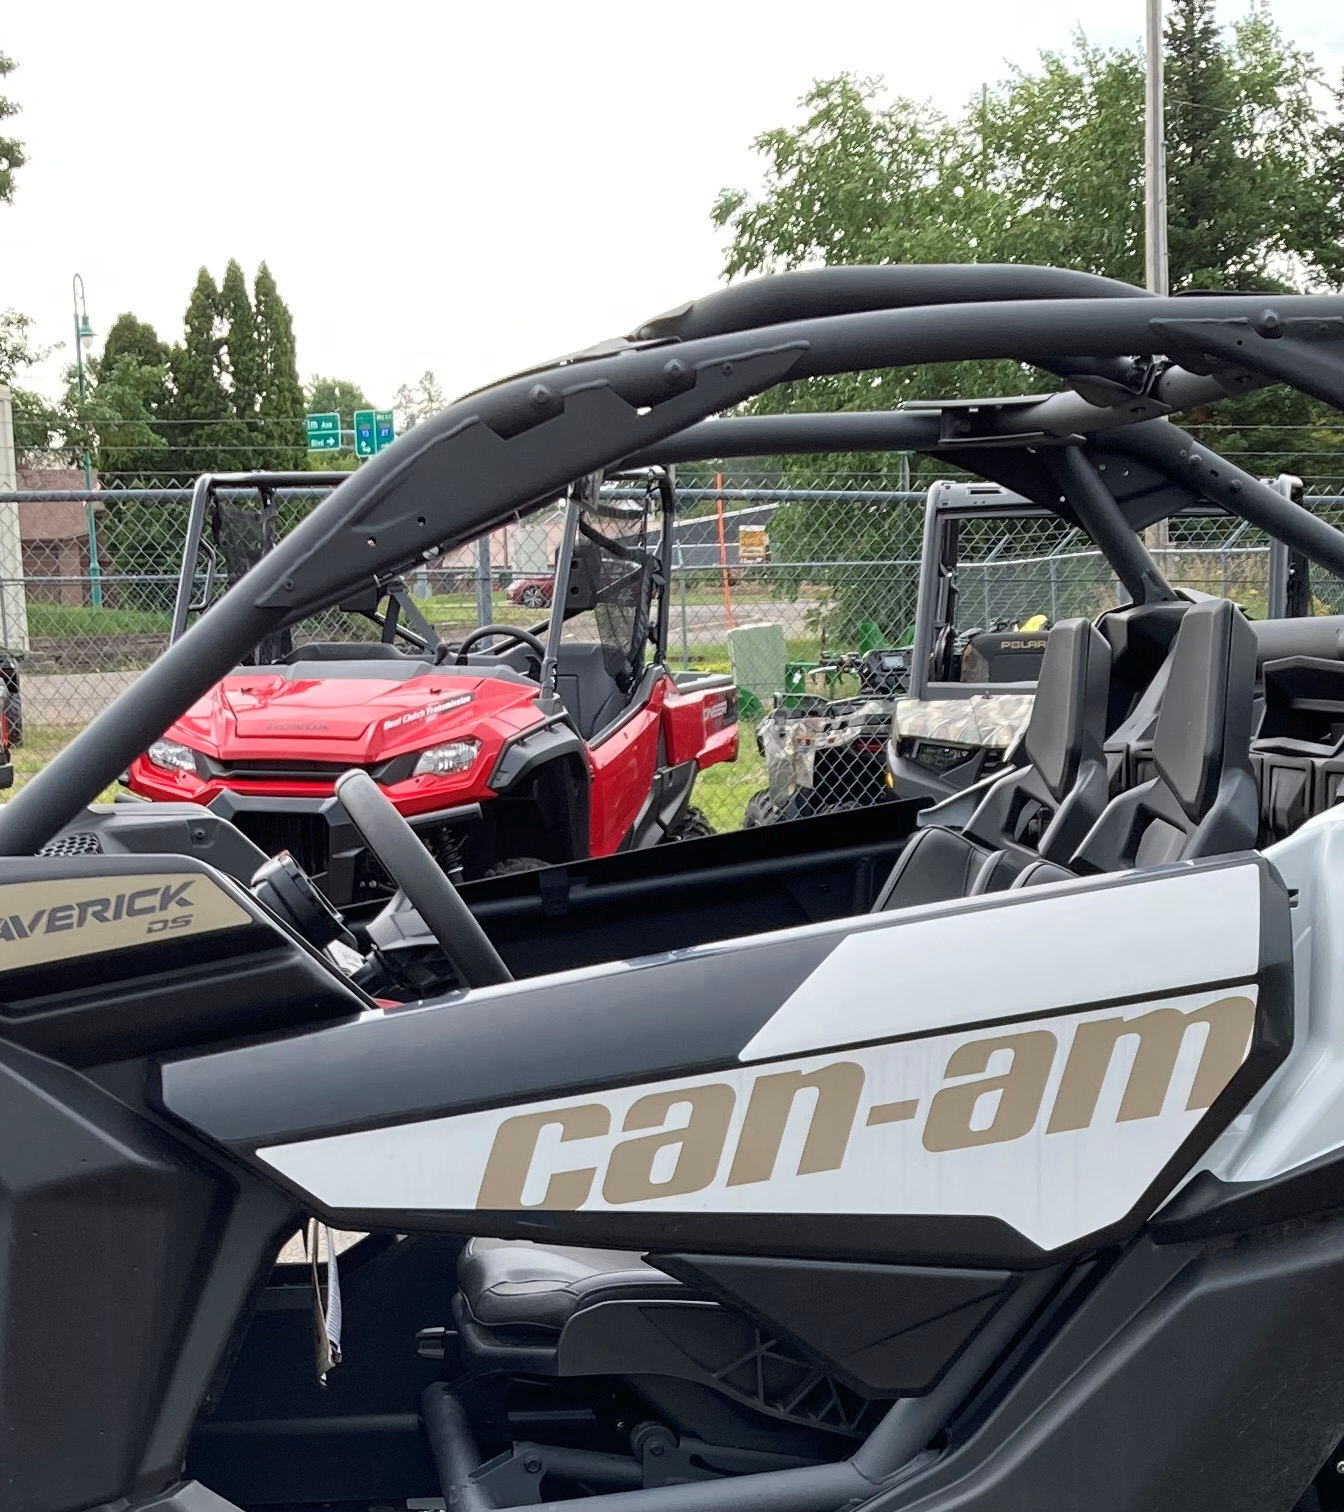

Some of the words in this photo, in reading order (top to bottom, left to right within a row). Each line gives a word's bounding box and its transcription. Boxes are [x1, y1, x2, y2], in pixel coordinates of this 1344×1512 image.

[1001, 640, 1046, 649] POLAR
[146, 913, 194, 935] DS
[475, 995, 1257, 1212] can-am
